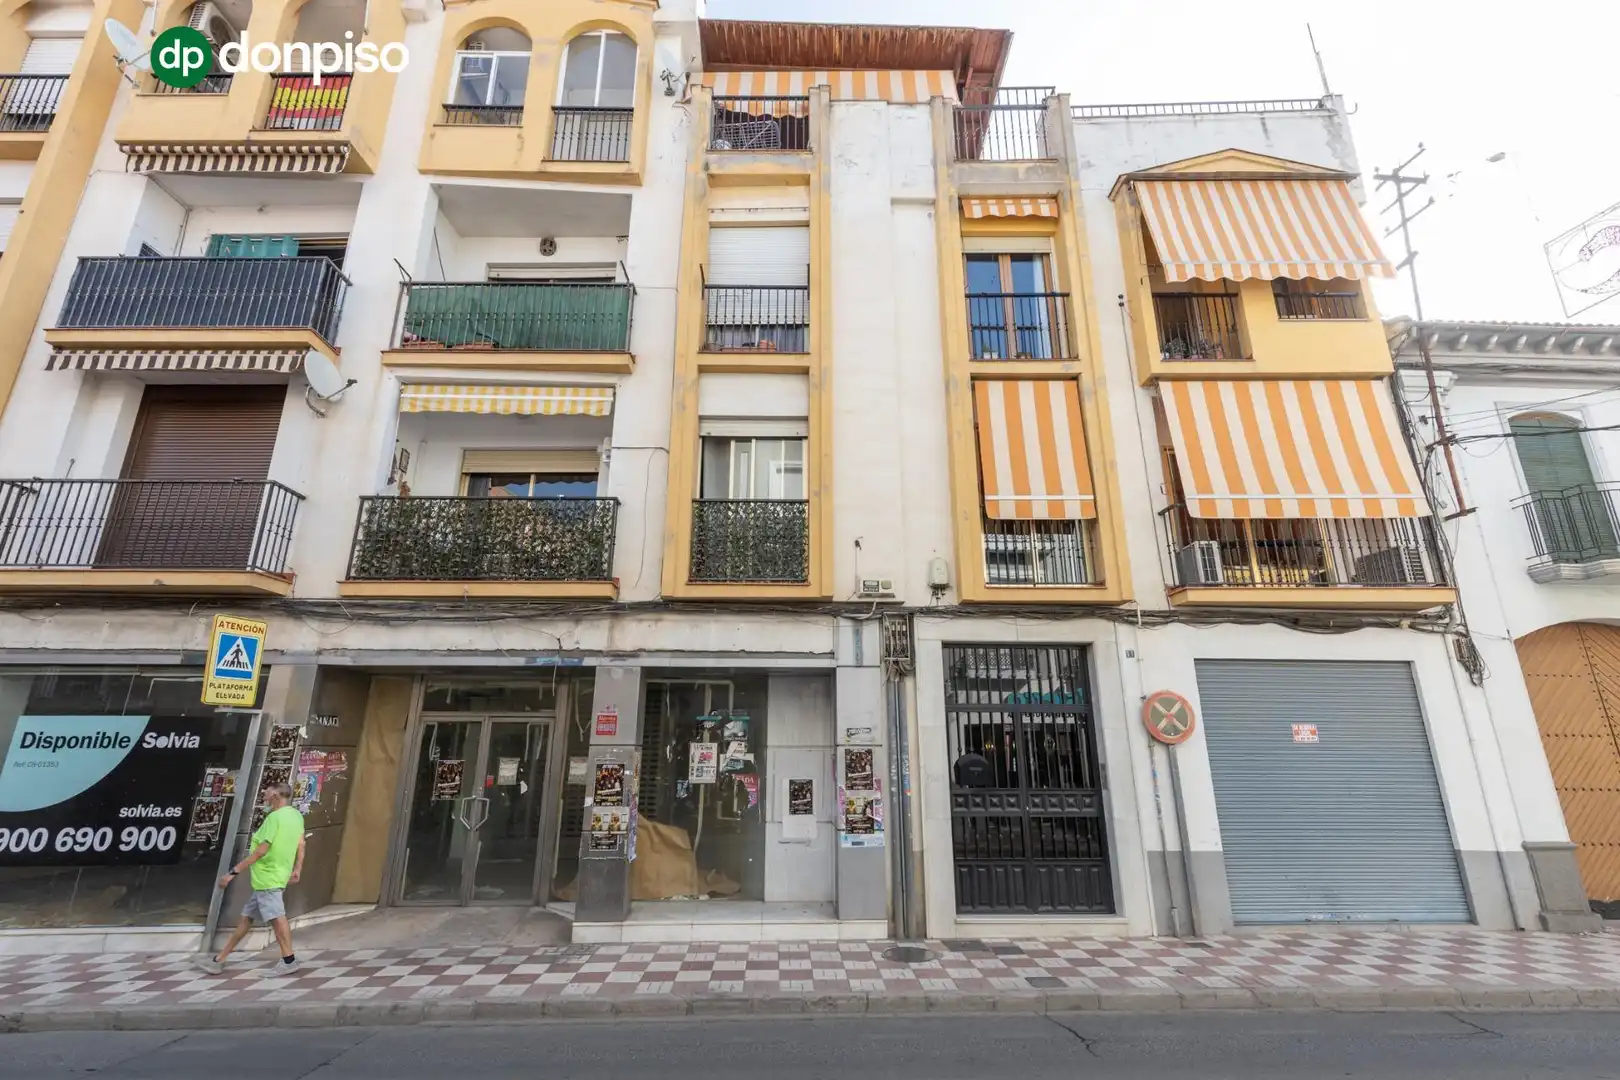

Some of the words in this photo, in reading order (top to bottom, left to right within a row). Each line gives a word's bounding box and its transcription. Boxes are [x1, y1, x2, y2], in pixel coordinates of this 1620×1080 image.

[218, 620, 264, 634] ATENCIÓN
[209, 682, 253, 691] PLATAFORMA
[215, 691, 245, 699] ELEVADA
[20, 731, 131, 752] Disponible
[142, 732, 200, 749] Solvia
[119, 804, 182, 818] solvia.es
[55, 827, 113, 853] 690
[118, 827, 177, 852] 900
